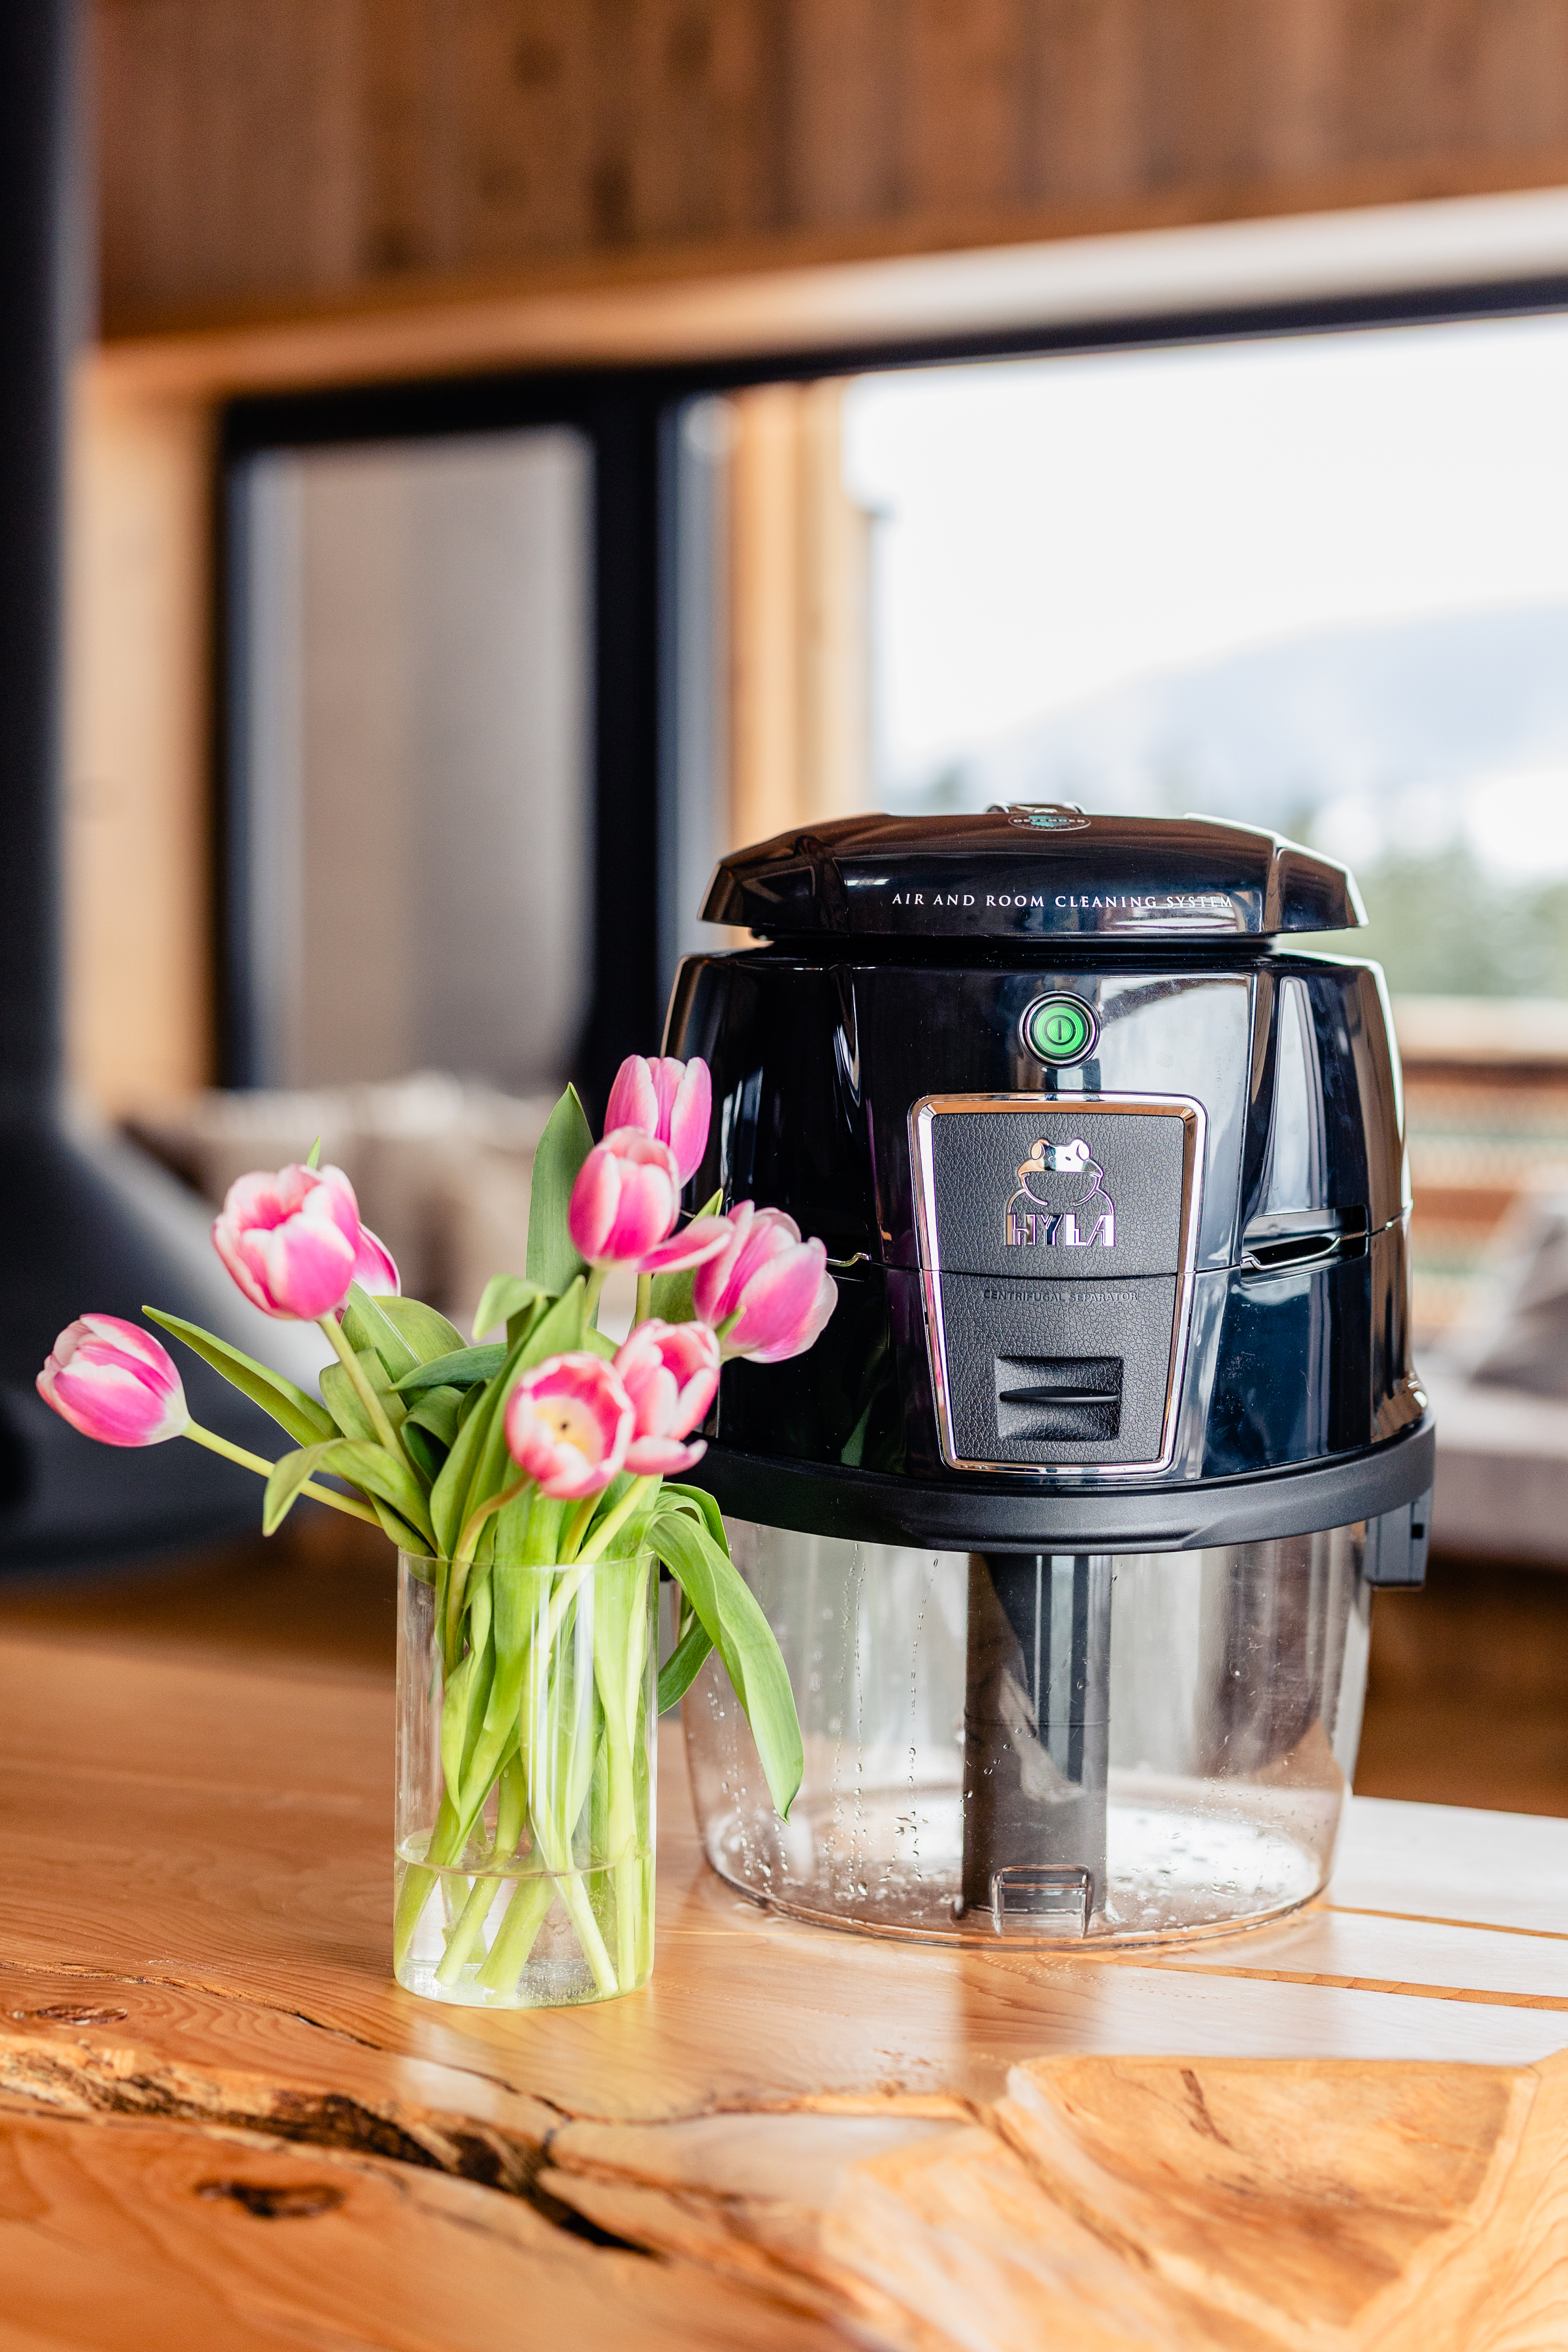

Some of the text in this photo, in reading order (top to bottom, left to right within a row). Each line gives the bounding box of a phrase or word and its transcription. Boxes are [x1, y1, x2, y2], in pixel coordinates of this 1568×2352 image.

[892, 893, 1233, 908] AIR AND ROOM CLEANING SYSTEM
[1006, 1213, 1115, 1246] HYLA
[983, 1289, 1138, 1303] CENTRIFUGAL SEPARATOR
